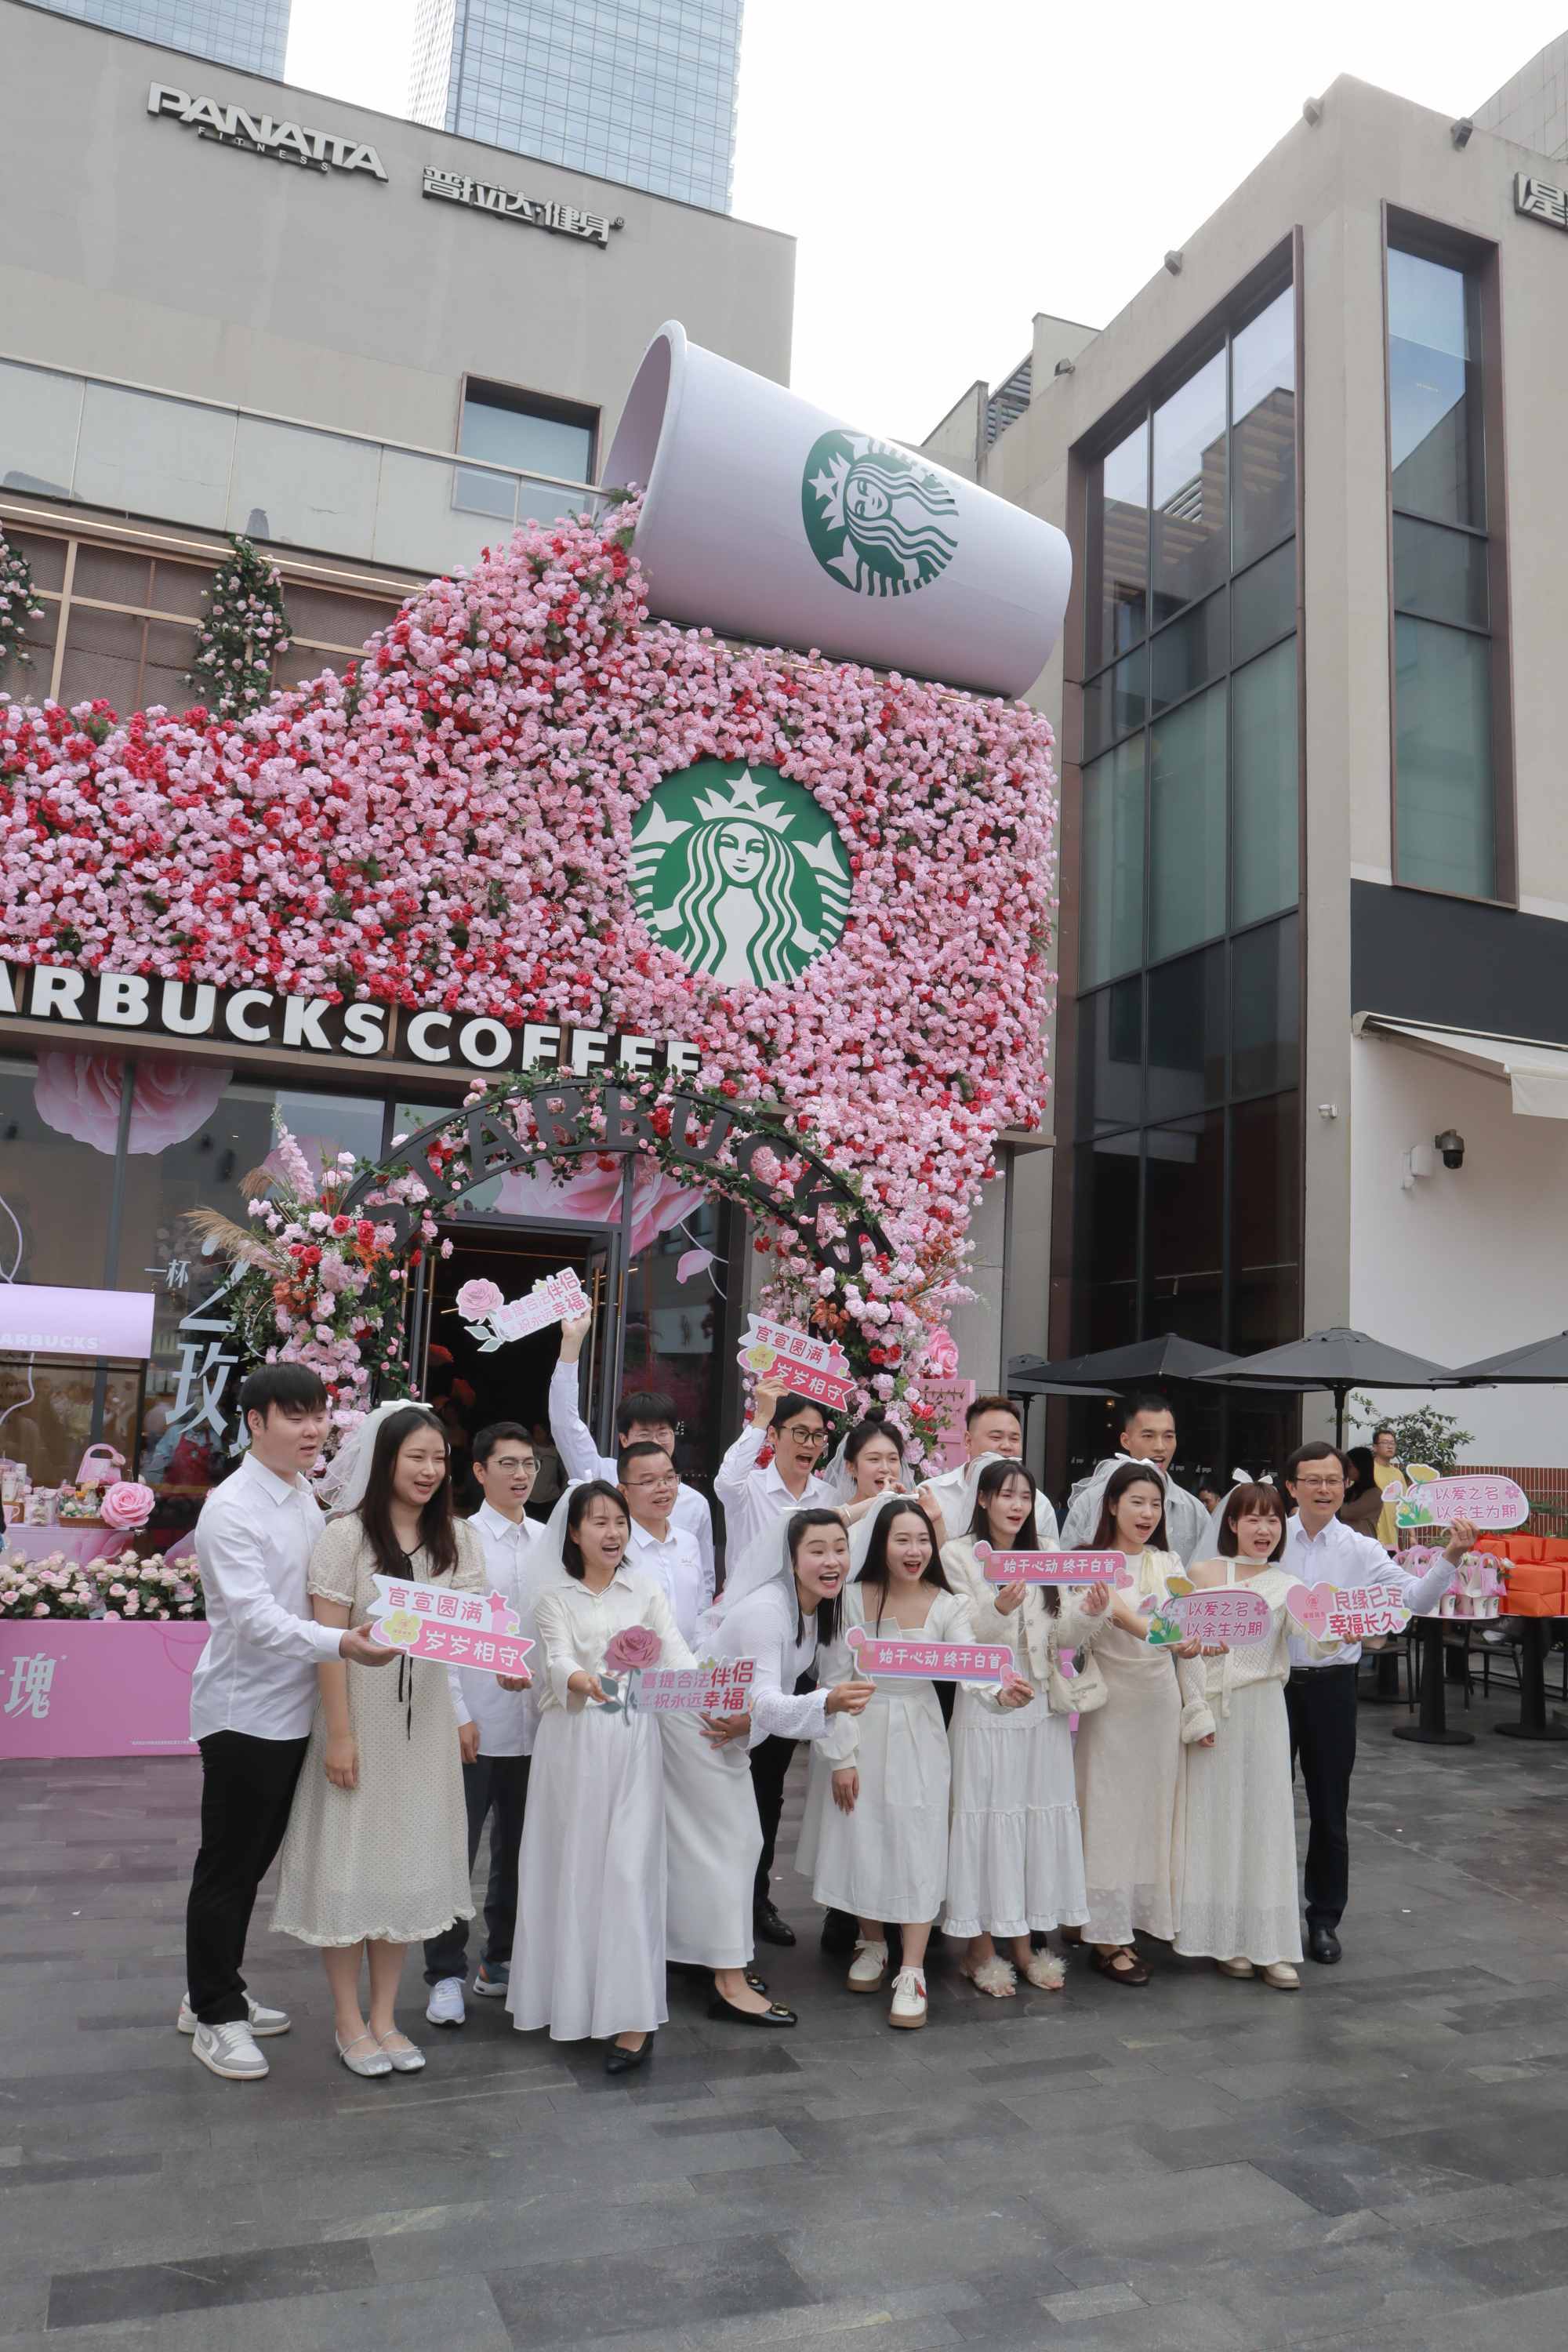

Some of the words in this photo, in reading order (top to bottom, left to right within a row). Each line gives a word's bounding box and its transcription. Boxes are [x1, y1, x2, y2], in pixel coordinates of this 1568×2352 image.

[148, 80, 389, 180] PANATTA
[198, 126, 328, 172] FITNESS
[407, 1011, 701, 1078] COFFEE
[144, 1258, 192, 1288] 一杯
[756, 1324, 825, 1364] 官宣圆满
[775, 1362, 843, 1402] 岁岁相守
[1436, 1486, 1500, 1501] 以爱之名
[1436, 1504, 1518, 1519] 以余生为期
[389, 1586, 484, 1624] 官宣圆满
[1188, 1601, 1250, 1617] 以爱之名
[1329, 1611, 1399, 1636] 幸福长久
[424, 1629, 520, 1668] 岁岁相守
[1186, 1621, 1263, 1638] 以余生为期
[0, 1653, 57, 1719] 瑰
